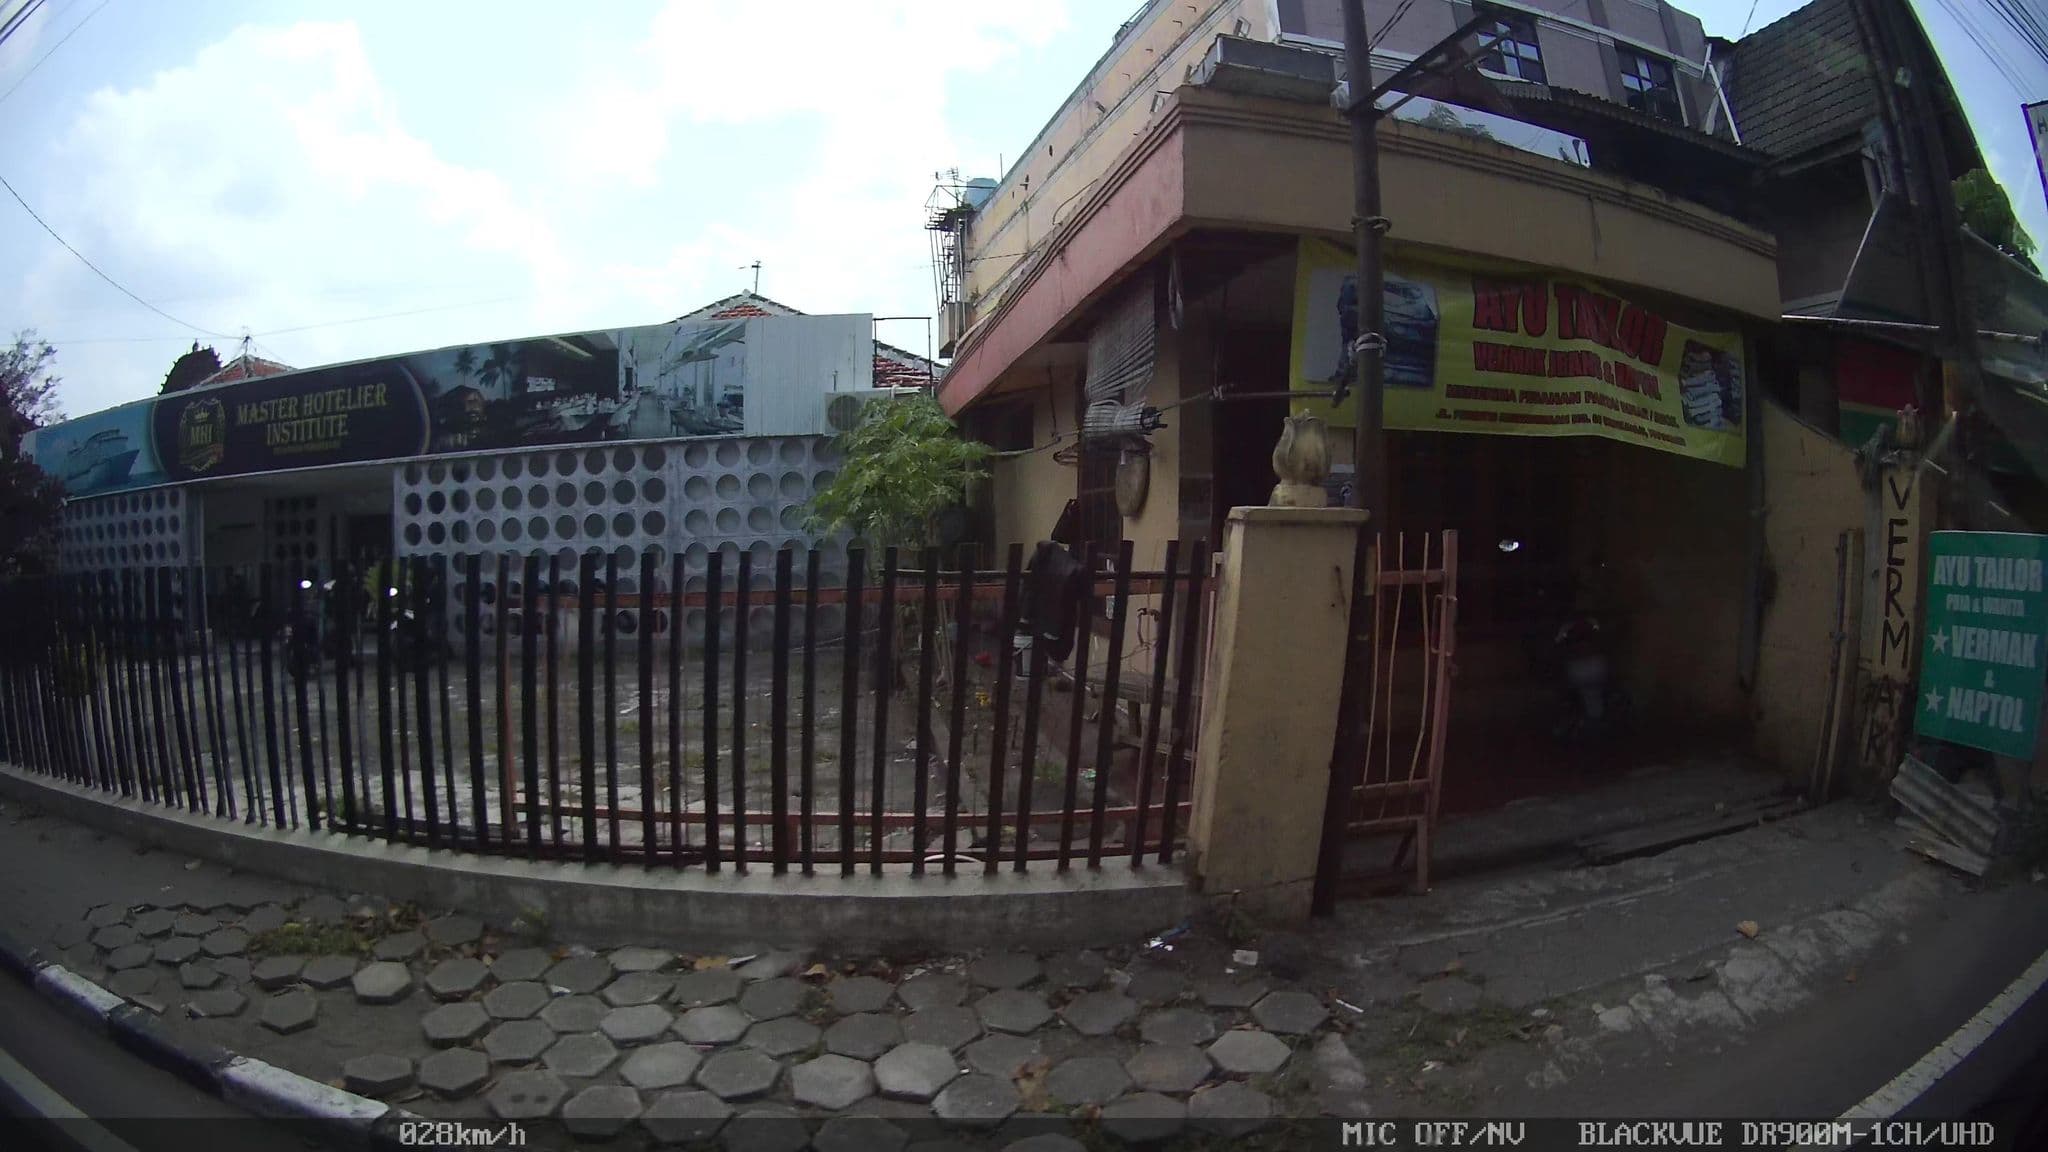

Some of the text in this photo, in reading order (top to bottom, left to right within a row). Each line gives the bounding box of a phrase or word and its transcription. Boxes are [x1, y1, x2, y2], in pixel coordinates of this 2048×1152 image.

[1473, 279, 1548, 337] AYU
[236, 383, 387, 426] MASTER HOTELIER
[190, 424, 213, 446] MHI
[266, 414, 349, 445] INSTITUTE
[1933, 555, 2043, 592] AYU TAILOR
[1951, 625, 2038, 668] VERMAK
[1984, 669, 1994, 688] &
[1946, 686, 2023, 733] NAPTOL
